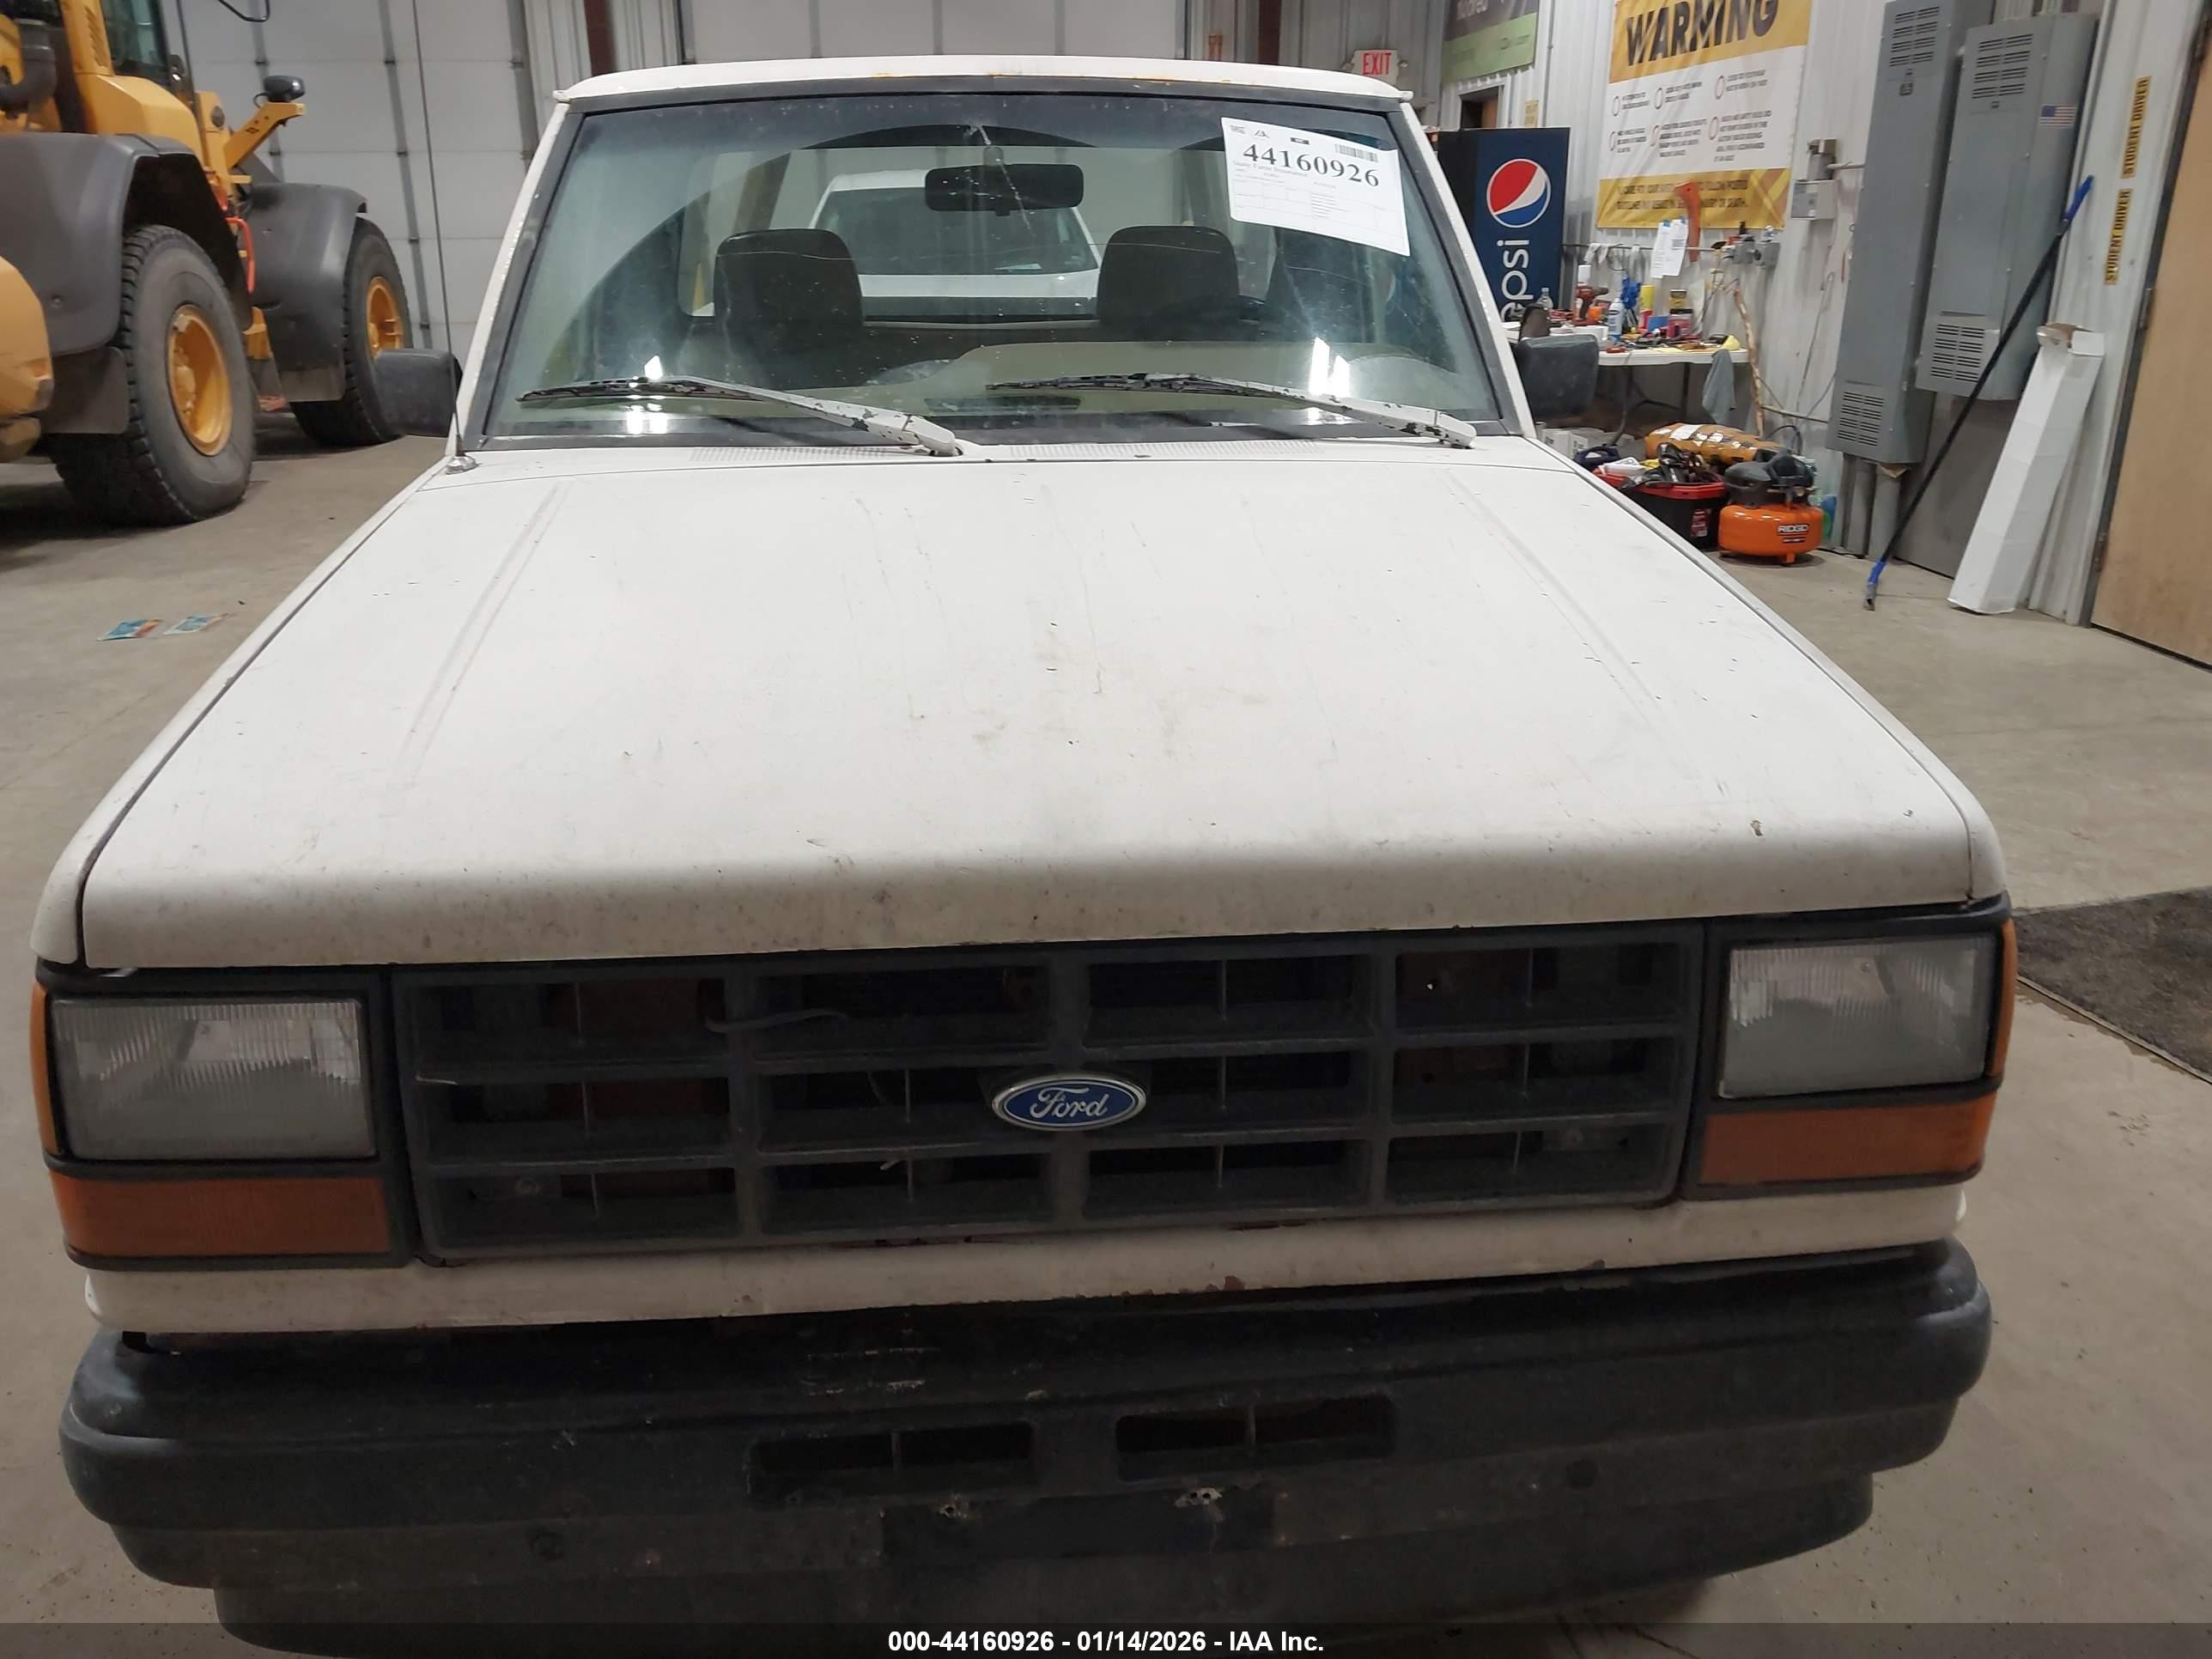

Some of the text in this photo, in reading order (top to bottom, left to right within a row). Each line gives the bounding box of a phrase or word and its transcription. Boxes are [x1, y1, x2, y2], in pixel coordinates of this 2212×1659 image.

[1626, 0, 1778, 66] WARNING
[1362, 52, 1393, 76] EXIT
[2122, 78, 2149, 174] STUDENT DRIVER
[1243, 143, 1380, 187] 44160926
[2105, 191, 2131, 282] STUDENT DRIVER
[1030, 1086, 1109, 1118] Ford
